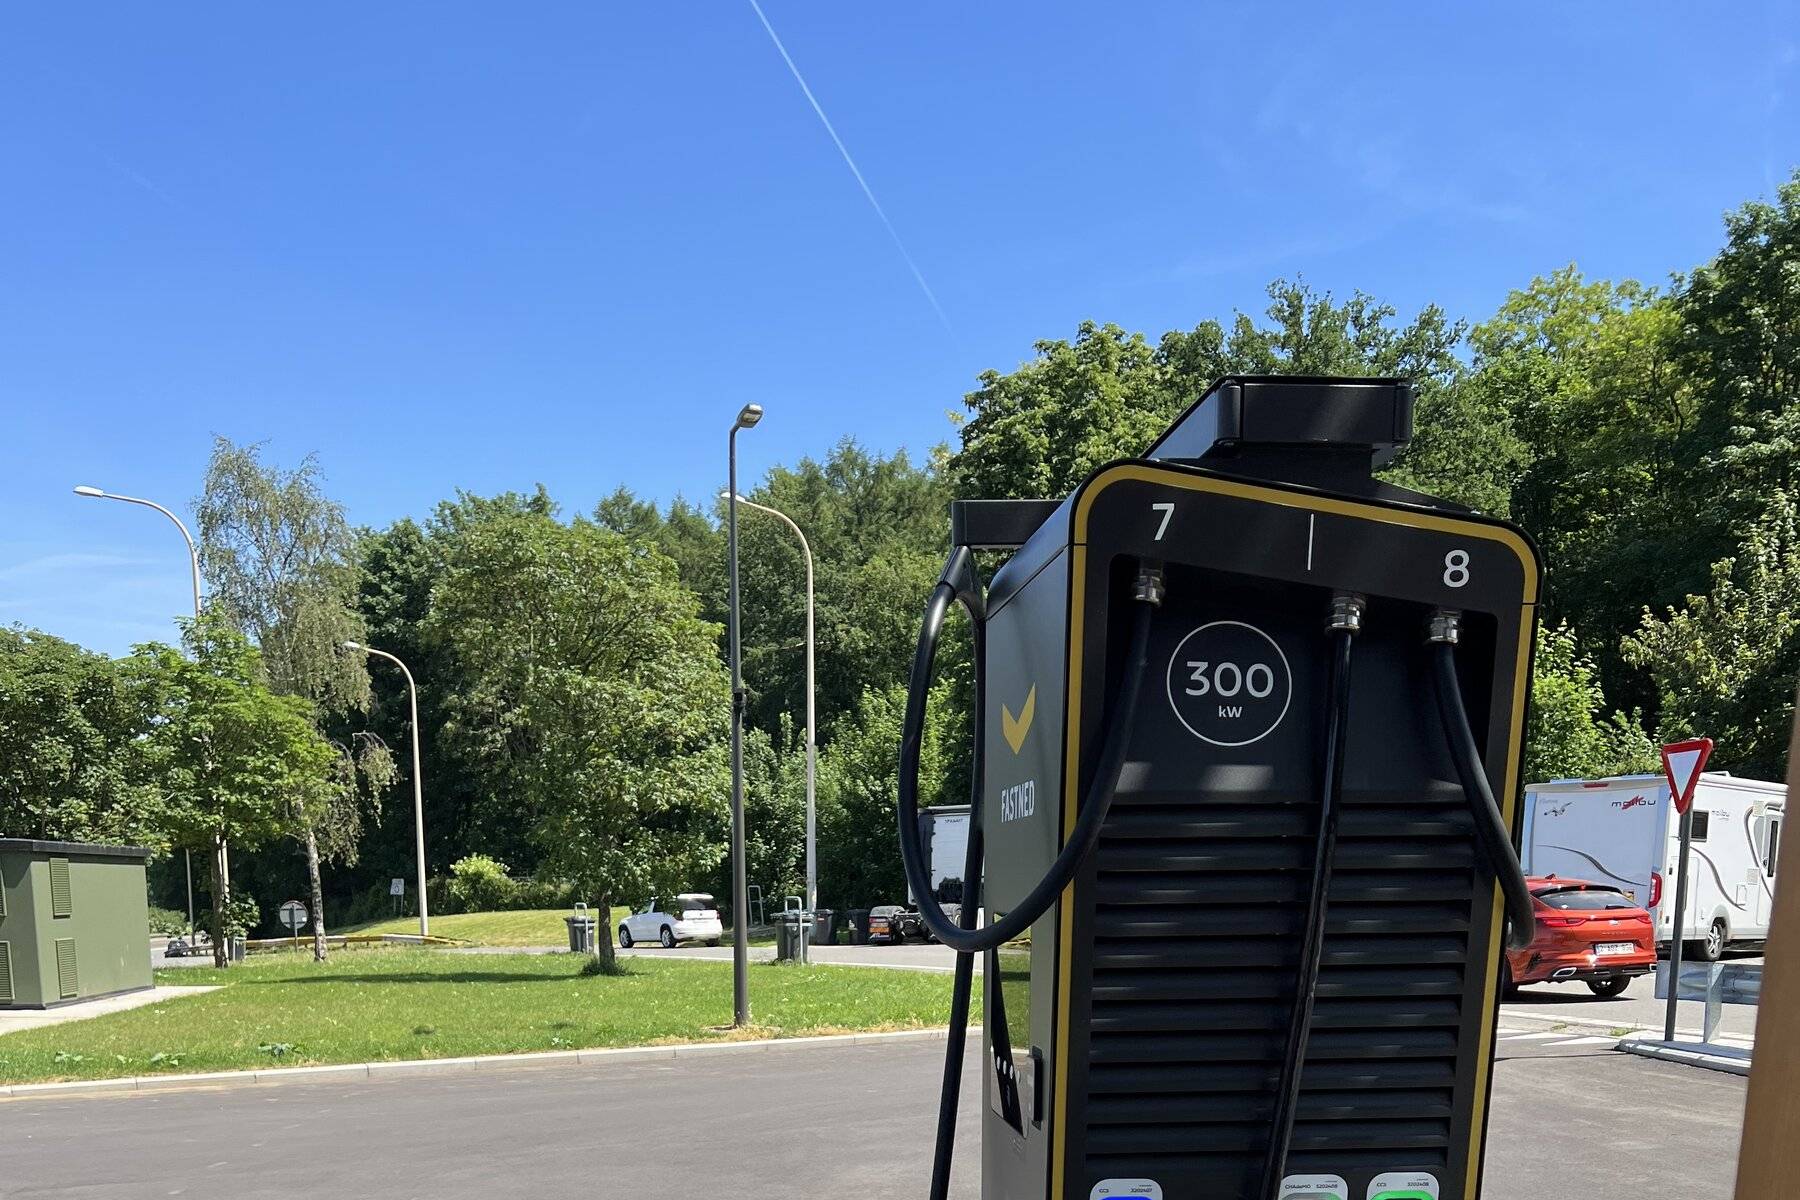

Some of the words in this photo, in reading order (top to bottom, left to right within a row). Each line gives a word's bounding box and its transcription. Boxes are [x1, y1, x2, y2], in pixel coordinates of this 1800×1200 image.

[1152, 503, 1175, 541] 7
[1443, 549, 1470, 588] 8
[1185, 661, 1274, 698] 300
[1218, 705, 1242, 718] kW
[1001, 780, 1034, 823] FASTNED
